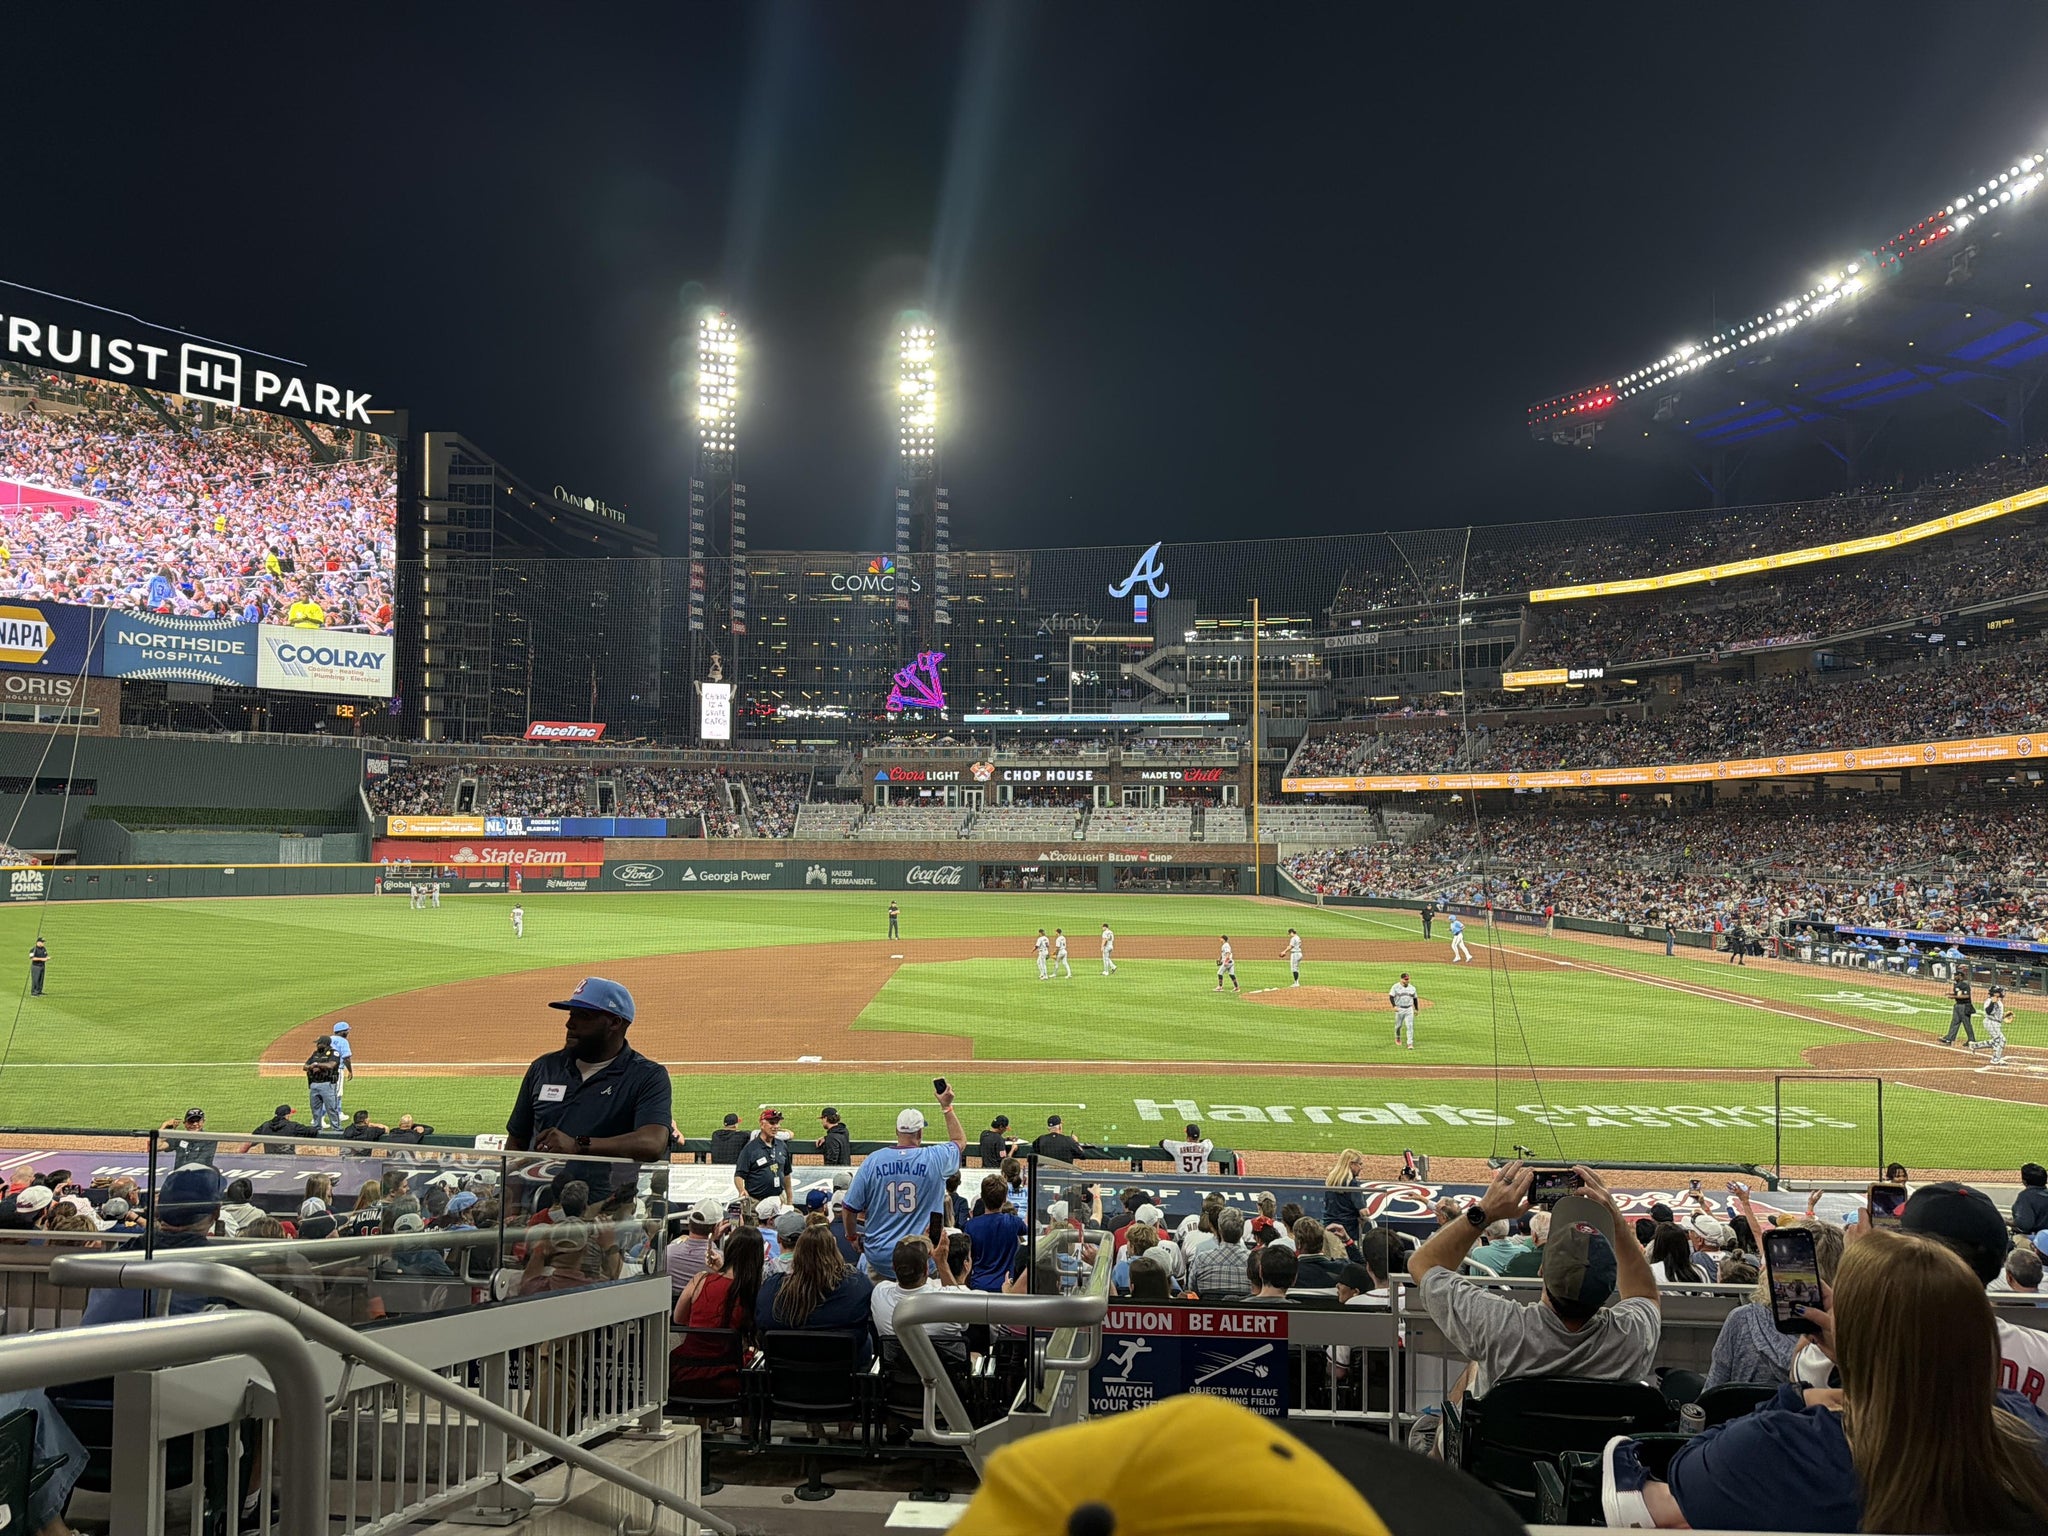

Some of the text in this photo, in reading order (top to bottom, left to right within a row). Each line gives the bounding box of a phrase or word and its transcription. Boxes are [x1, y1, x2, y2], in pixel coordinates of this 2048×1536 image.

[0, 314, 373, 425] RUIST PARK
[692, 480, 704, 488] 1872
[692, 508, 704, 517] 1877
[118, 631, 245, 655] NORTHSIDE
[142, 649, 222, 665] HOSPITAL
[277, 644, 387, 670] COOLRAY
[308, 665, 364, 676] Cooling Heating
[1569, 669, 1588, 680] 8:51
[1589, 668, 1604, 678] PM
[314, 672, 381, 684] Plumbing Electrical
[5, 676, 72, 696] ORIS
[530, 724, 597, 738] RaceTrac
[890, 767, 960, 781] Coors LIGHT
[1003, 770, 1093, 781] CHOP HOUSE
[1169, 771, 1182, 779] TO
[1184, 768, 1223, 782] Chill
[486, 821, 504, 832] NL
[1050, 850, 1173, 862] Coors LIGHT BELOW CHOP
[11, 870, 44, 883] PAPA
[622, 865, 657, 880] Ford
[700, 871, 772, 883] Georgia Power
[10, 883, 44, 892] JOHNS
[555, 880, 587, 888] National
[1515, 1104, 1828, 1117] CHEROKEE
[1534, 1116, 1857, 1129] CASINOS
[1183, 1156, 1202, 1172] 57
[886, 1181, 917, 1214] 13
[1101, 1311, 1278, 1333] AUTION BE ALERT
[1105, 1385, 1153, 1399] WATCH
[1189, 1386, 1279, 1397] OBJECTS MAY LEAVE
[1091, 1398, 1128, 1411] YOUR
[1251, 1397, 1276, 1406] FIELD
[1249, 1407, 1281, 1416] INJURY
